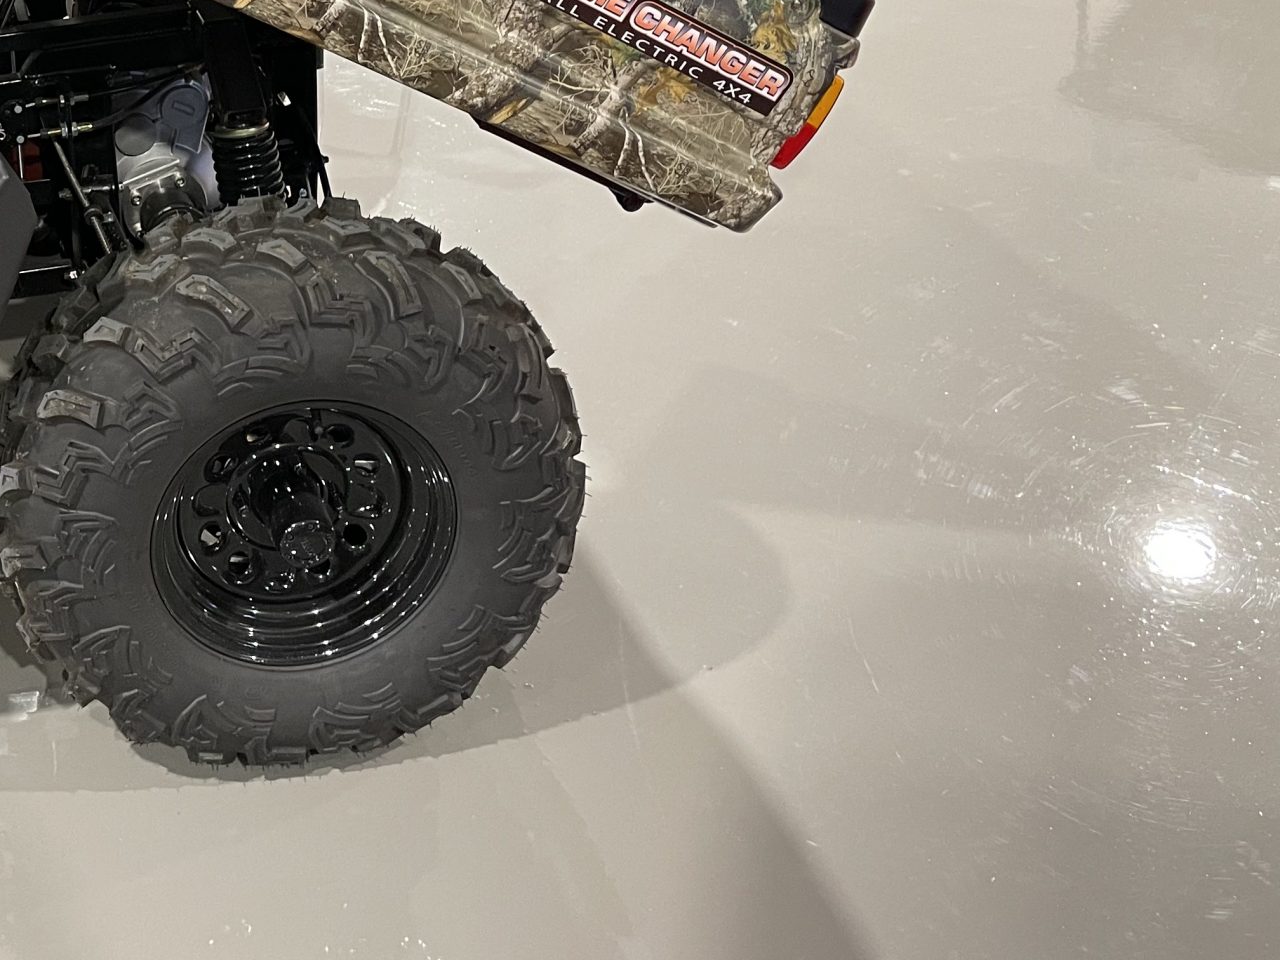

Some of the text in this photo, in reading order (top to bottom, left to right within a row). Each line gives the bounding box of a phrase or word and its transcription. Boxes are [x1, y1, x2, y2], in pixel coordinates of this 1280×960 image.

[593, 18, 703, 80] ELECTRIC
[713, 77, 753, 104] 4X4
[632, 3, 788, 100] CHANGER
